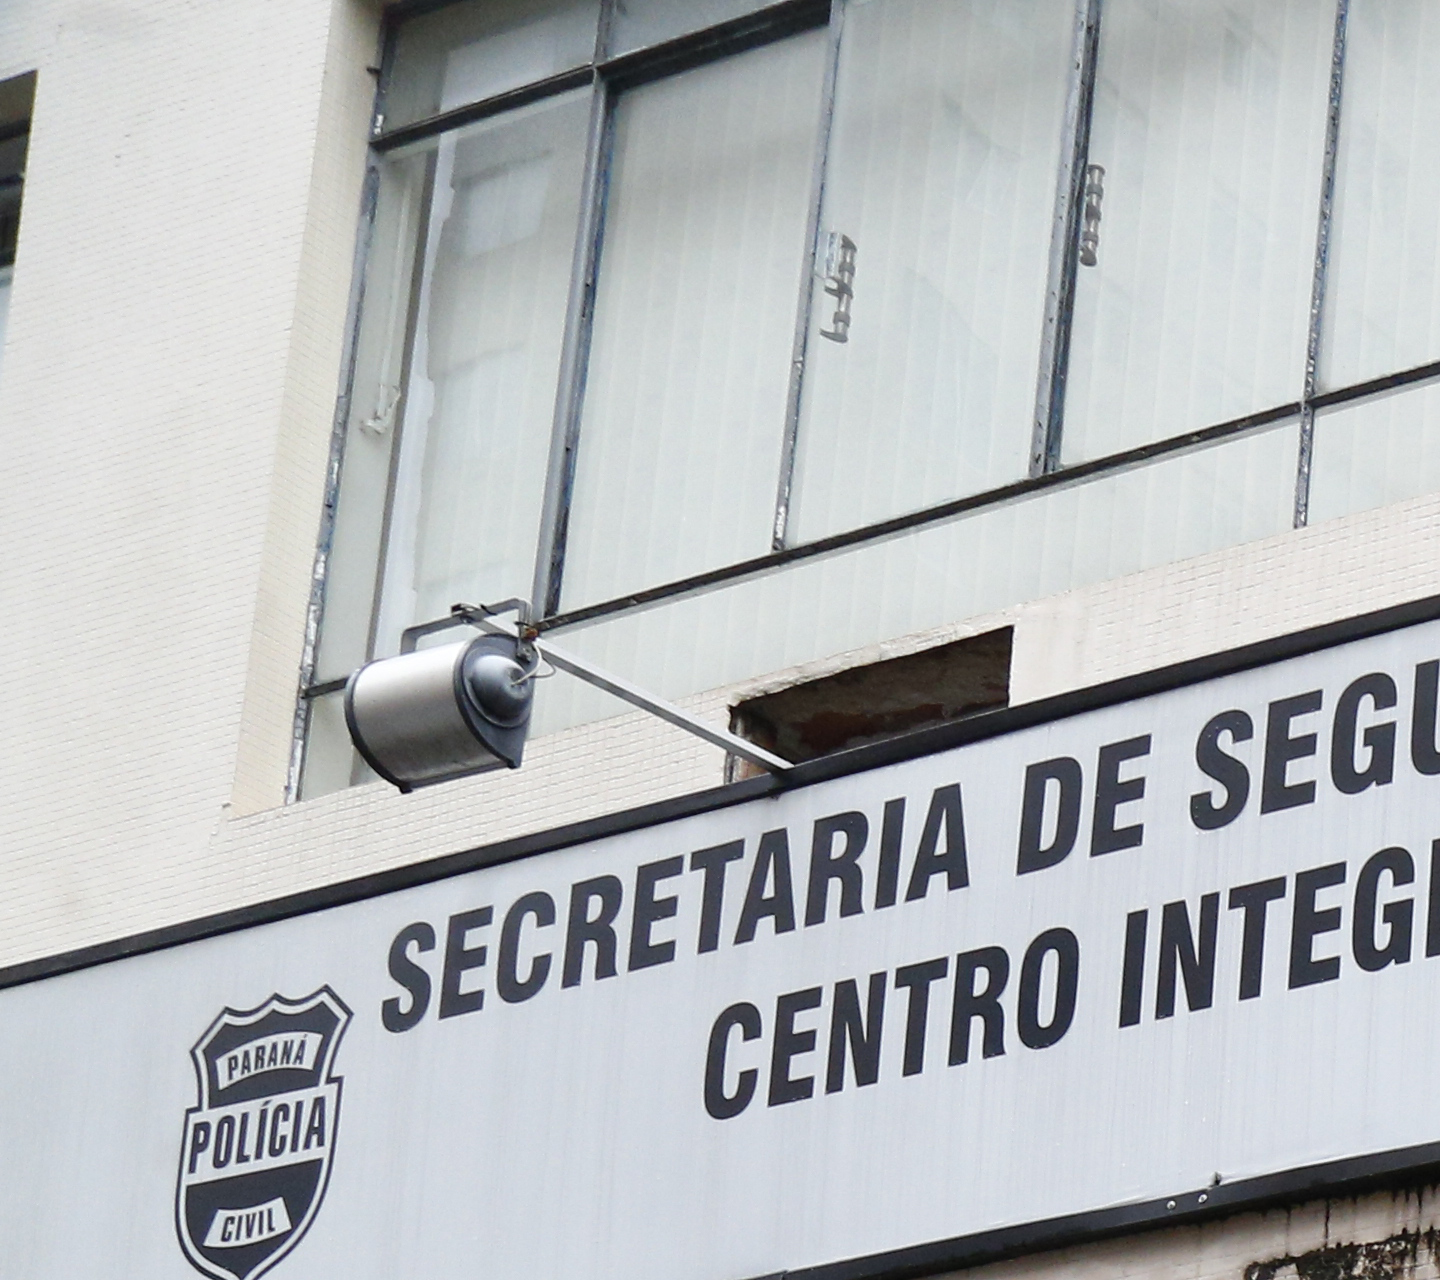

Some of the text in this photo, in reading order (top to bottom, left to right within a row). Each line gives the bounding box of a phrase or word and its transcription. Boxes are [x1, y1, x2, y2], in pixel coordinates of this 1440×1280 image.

[382, 784, 969, 1032] SECRETARIA
[1017, 735, 1151, 875] DE
[227, 1034, 308, 1081] PARANÁ
[705, 928, 1079, 1119] CENTRO
[188, 1096, 326, 1175] POLÍCIA
[220, 1207, 276, 1242] CIVIL
